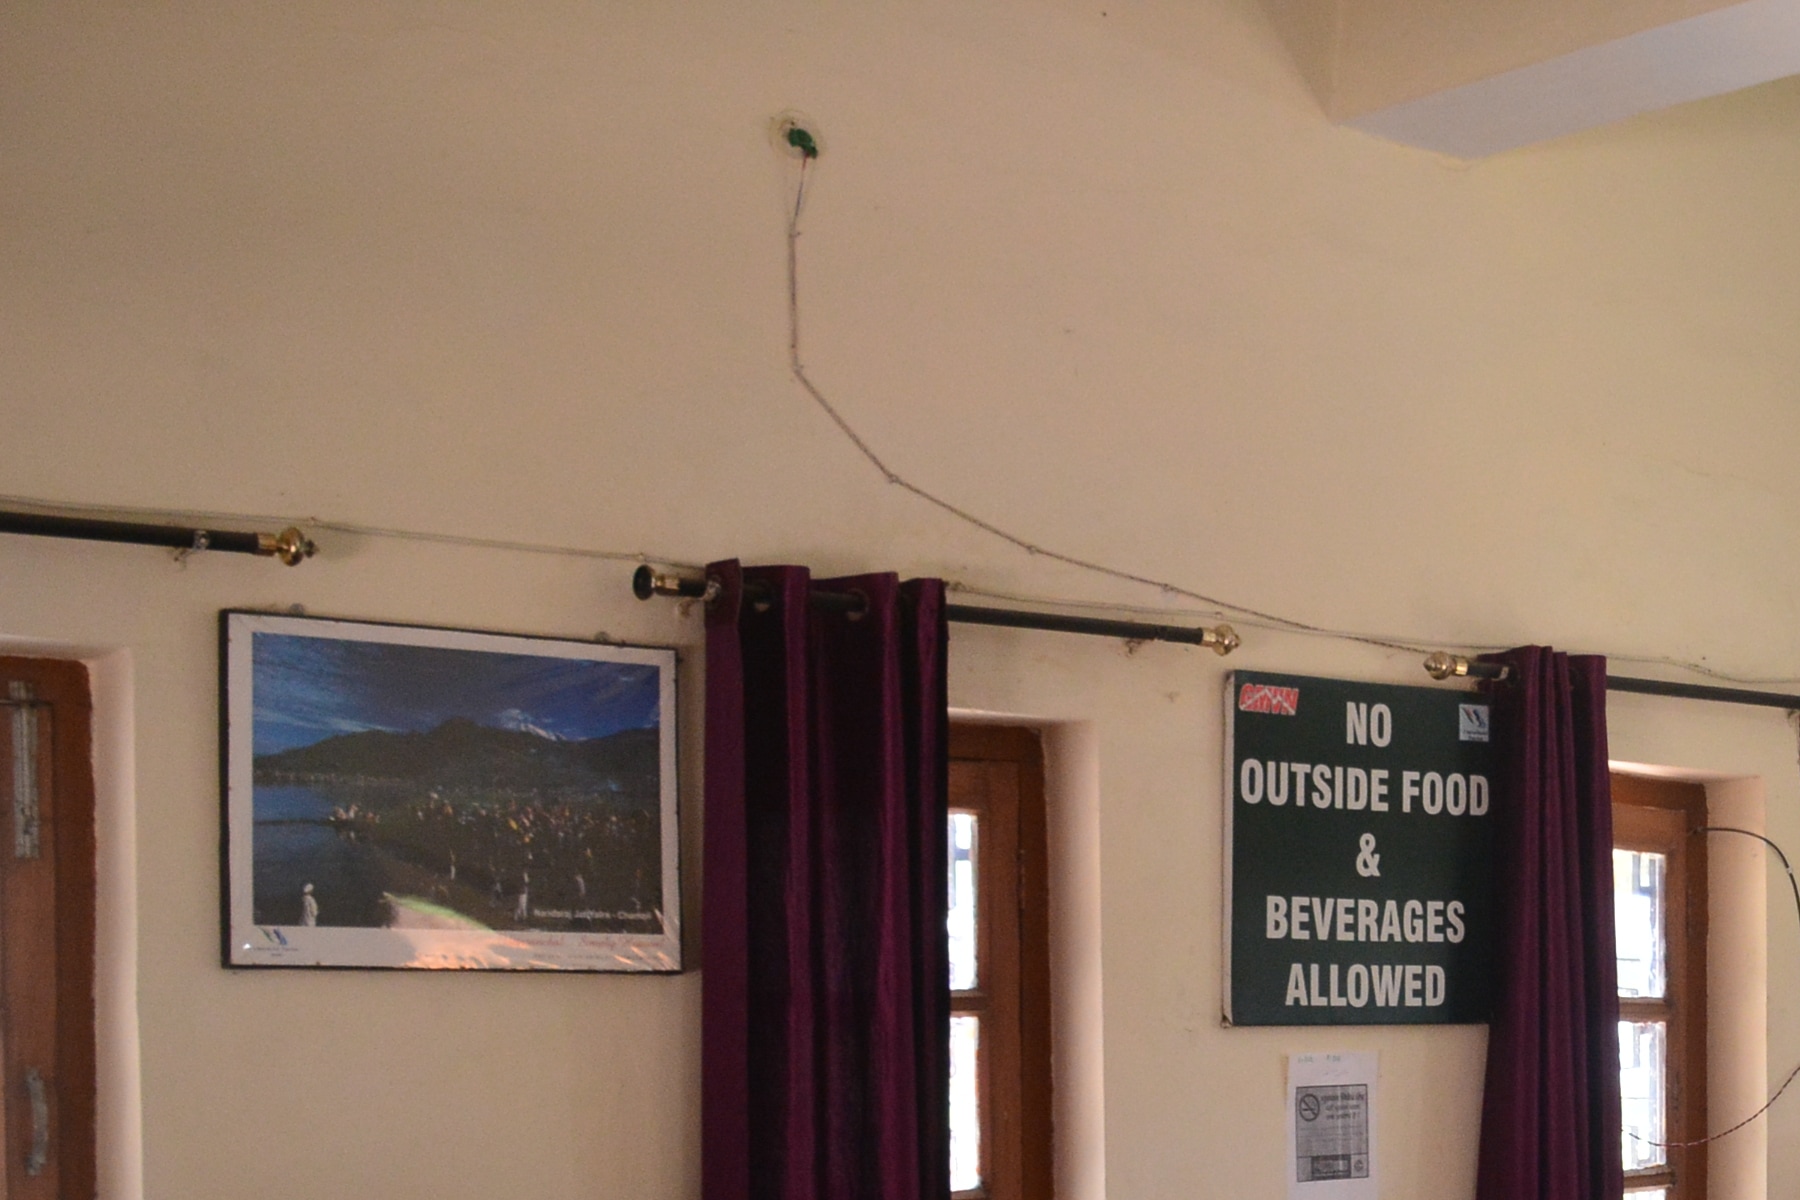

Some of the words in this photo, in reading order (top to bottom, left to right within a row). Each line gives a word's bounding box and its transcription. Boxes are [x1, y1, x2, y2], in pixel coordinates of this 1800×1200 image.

[1346, 701, 1392, 747] NO
[1240, 758, 1389, 812] OUTSIDE
[1402, 770, 1489, 816] FOOD
[1356, 833, 1381, 877] &
[1266, 895, 1466, 944] BEVERAGES
[1285, 963, 1446, 1007] ALLOWED
